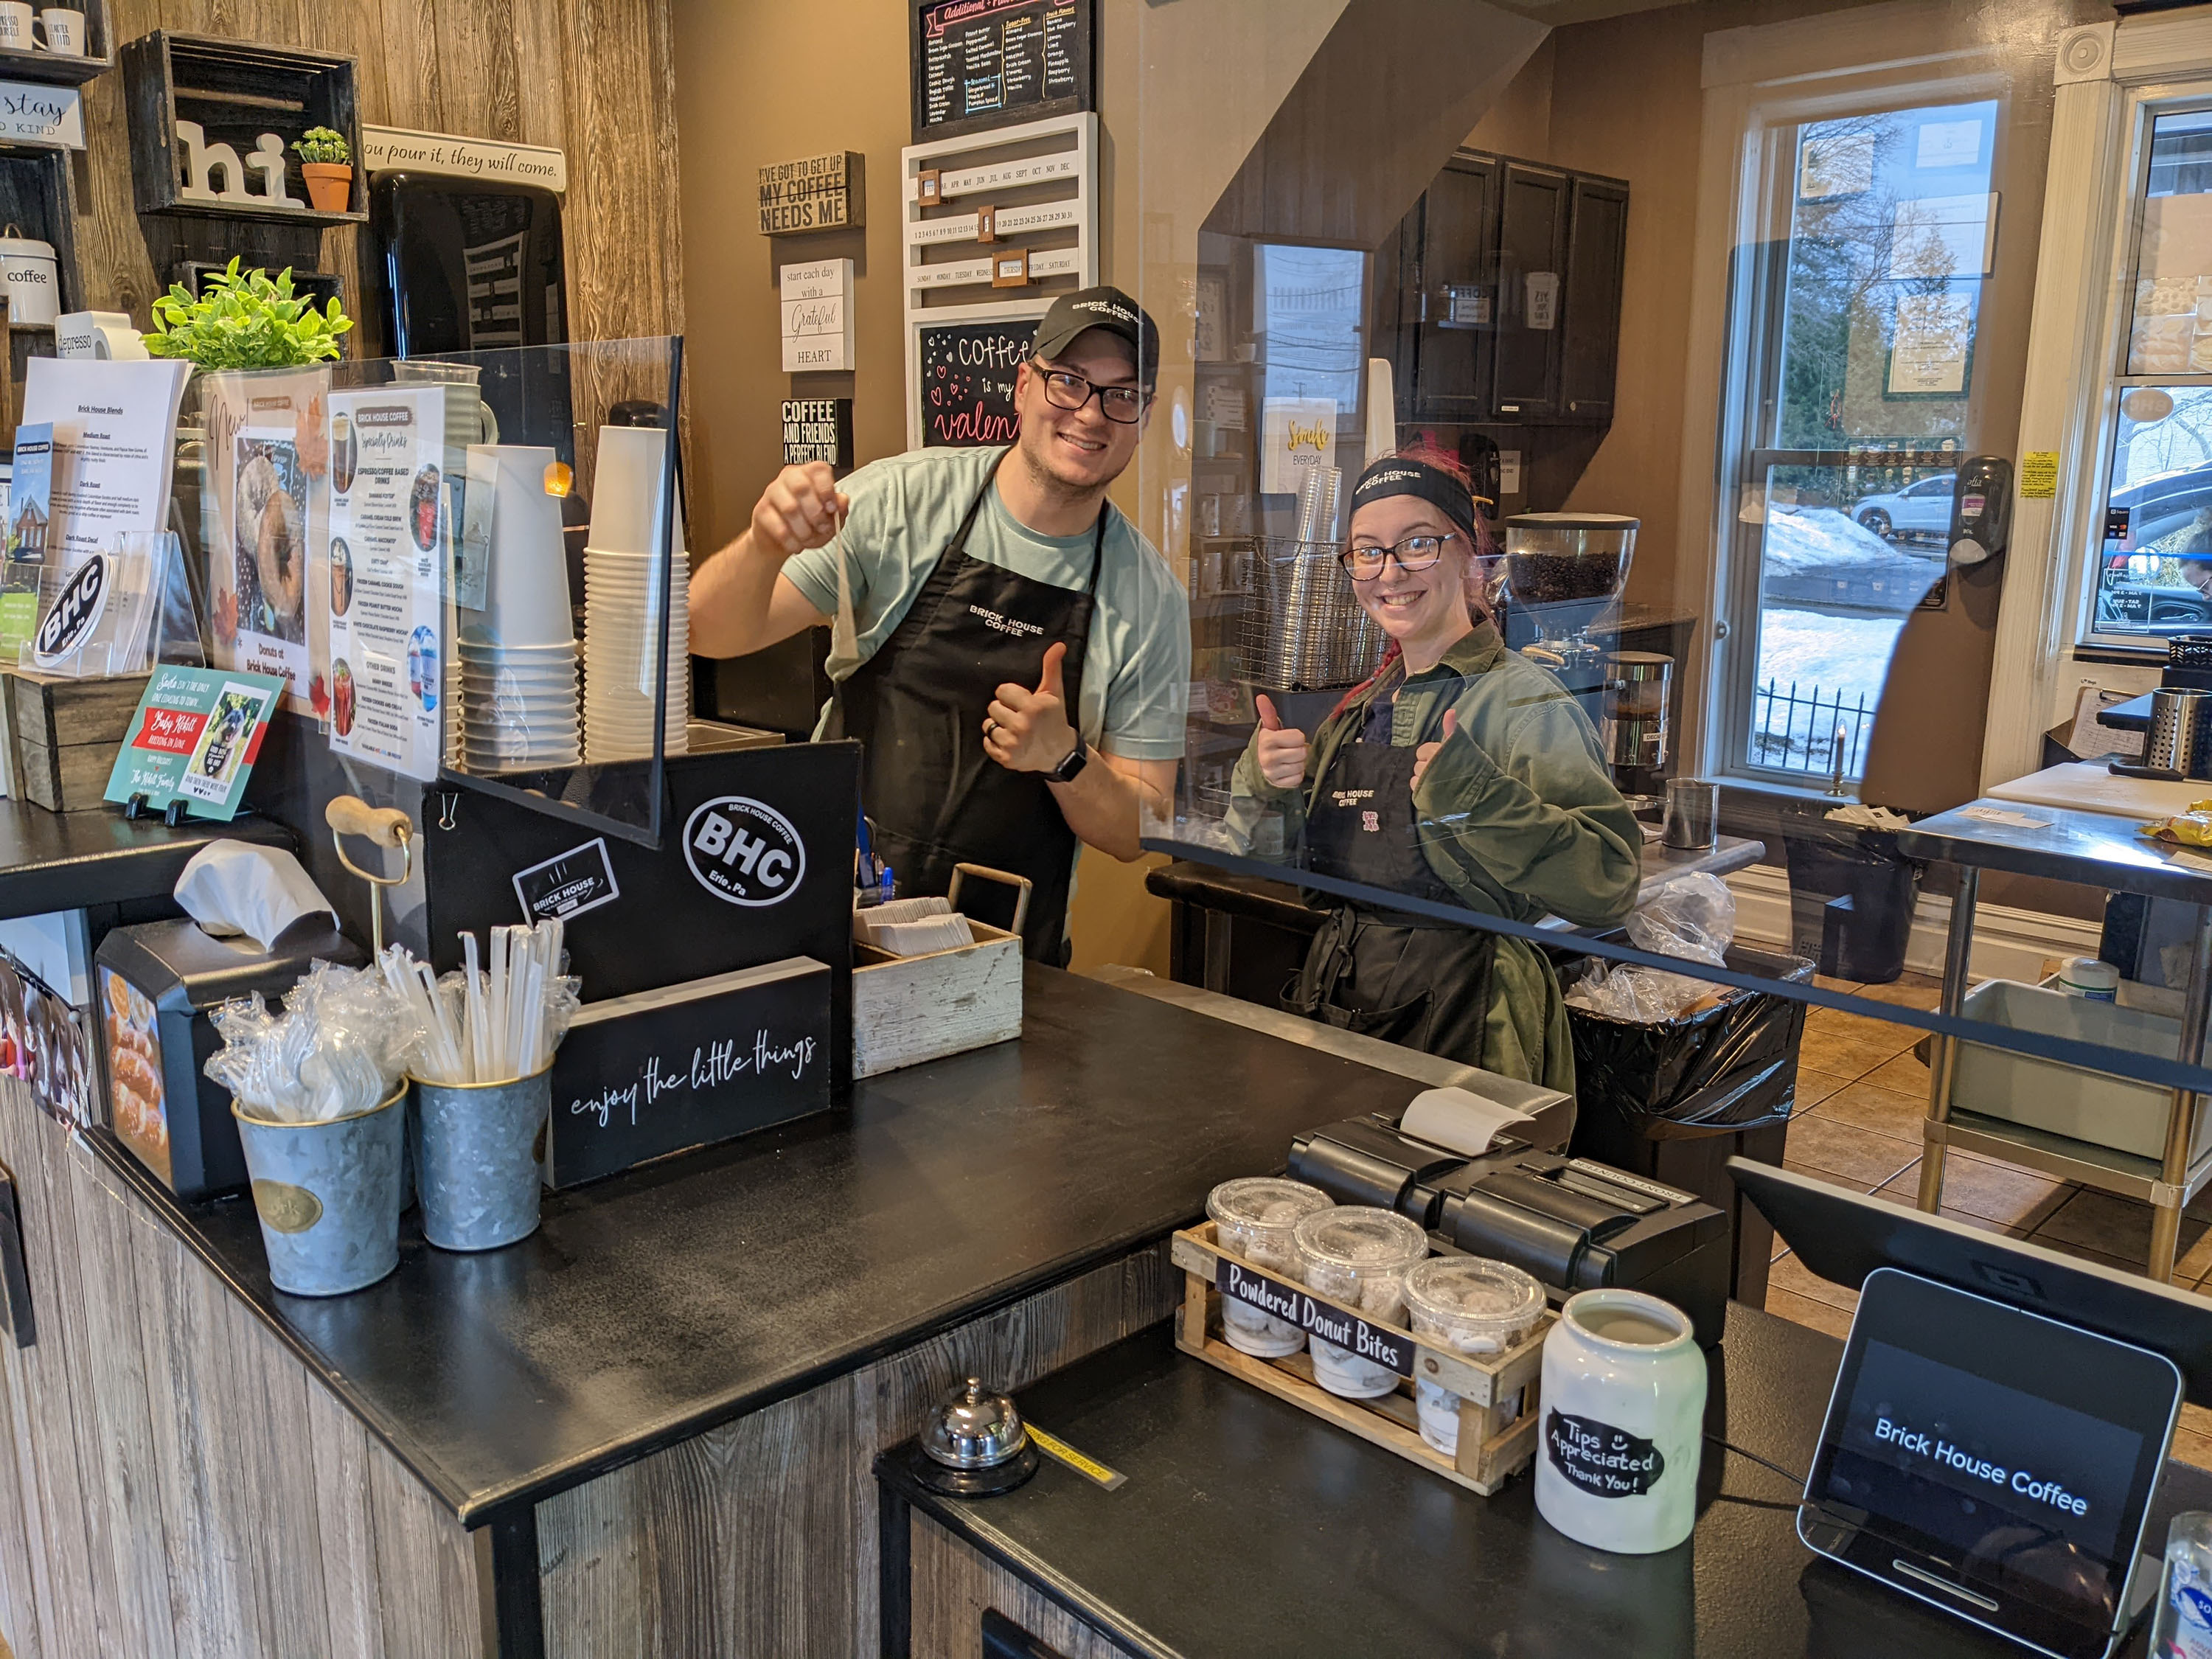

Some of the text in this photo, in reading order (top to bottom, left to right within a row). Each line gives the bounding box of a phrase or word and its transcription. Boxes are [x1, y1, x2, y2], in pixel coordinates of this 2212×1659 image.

[4, 93, 67, 125] stay
[16, 123, 55, 135] KIND
[175, 119, 305, 209] hi
[364, 143, 557, 176] ou pour it, they will come.
[759, 155, 842, 184] I'VE GOT TO GET UP
[976, 177, 985, 185] JUN
[989, 175, 998, 183] JUL
[1015, 170, 1027, 178] SEPT
[1032, 167, 1041, 175] OCT
[1046, 164, 1055, 173] NOV
[759, 173, 843, 208] MY COFFEE
[760, 198, 844, 232] NEEDS ME
[787, 265, 834, 282] start each day
[1048, 260, 1071, 269] SATURDAY
[7, 270, 46, 284] coffee
[801, 287, 818, 297] with
[1072, 301, 1107, 310] BRICK
[1089, 306, 1130, 321] COFFEE
[791, 303, 836, 343] Grateful
[58, 335, 91, 354] depresso
[797, 349, 832, 364] HEART
[982, 378, 1015, 401] is my
[77, 405, 123, 415] Brick House Blends
[373, 413, 389, 422] HOUSE
[389, 412, 408, 421] COFFEE
[782, 400, 835, 423] COFFEE
[83, 431, 99, 439] Medium
[362, 432, 386, 454] Specialty
[784, 422, 835, 444] AND FRIENDS
[1288, 418, 1329, 451] Smile
[784, 445, 789, 465] A
[790, 444, 815, 465] PERFECT
[1293, 455, 1322, 466] EVERYDAY
[1366, 475, 1402, 490] COFFEE
[45, 563, 99, 652] BHC
[77, 617, 85, 629] Pa
[970, 605, 1044, 635] BRICK HOUSE
[985, 619, 1024, 637] COFFEE
[258, 642, 284, 659] Donuts at
[247, 658, 296, 681] Brick House Coffee
[380, 664, 395, 675] DRINKS
[156, 672, 178, 691] Santa
[151, 710, 174, 736] Baby
[167, 737, 174, 747] IN
[173, 737, 186, 748] JUNE
[1347, 790, 1374, 798] HOUSE
[728, 804, 793, 845] BRICK HOUSE COFFEE
[693, 811, 793, 888] BHC
[533, 891, 561, 911] BRICK
[562, 877, 594, 897] HOUSE
[732, 882, 747, 897] Pa
[571, 1029, 817, 1127] enjoy the little things
[1573, 1160, 1683, 1200] FRONT COUNTER
[1229, 1263, 1399, 1368] Powdered Donut Bites
[1563, 1418, 1600, 1453] Tips
[1028, 1427, 1107, 1478] RING FOR SERVICE
[1551, 1428, 1655, 1472] Appreciated
[1564, 1461, 1639, 1494] Thank You!
[1875, 1416, 2089, 1518] Brick House Coffee
